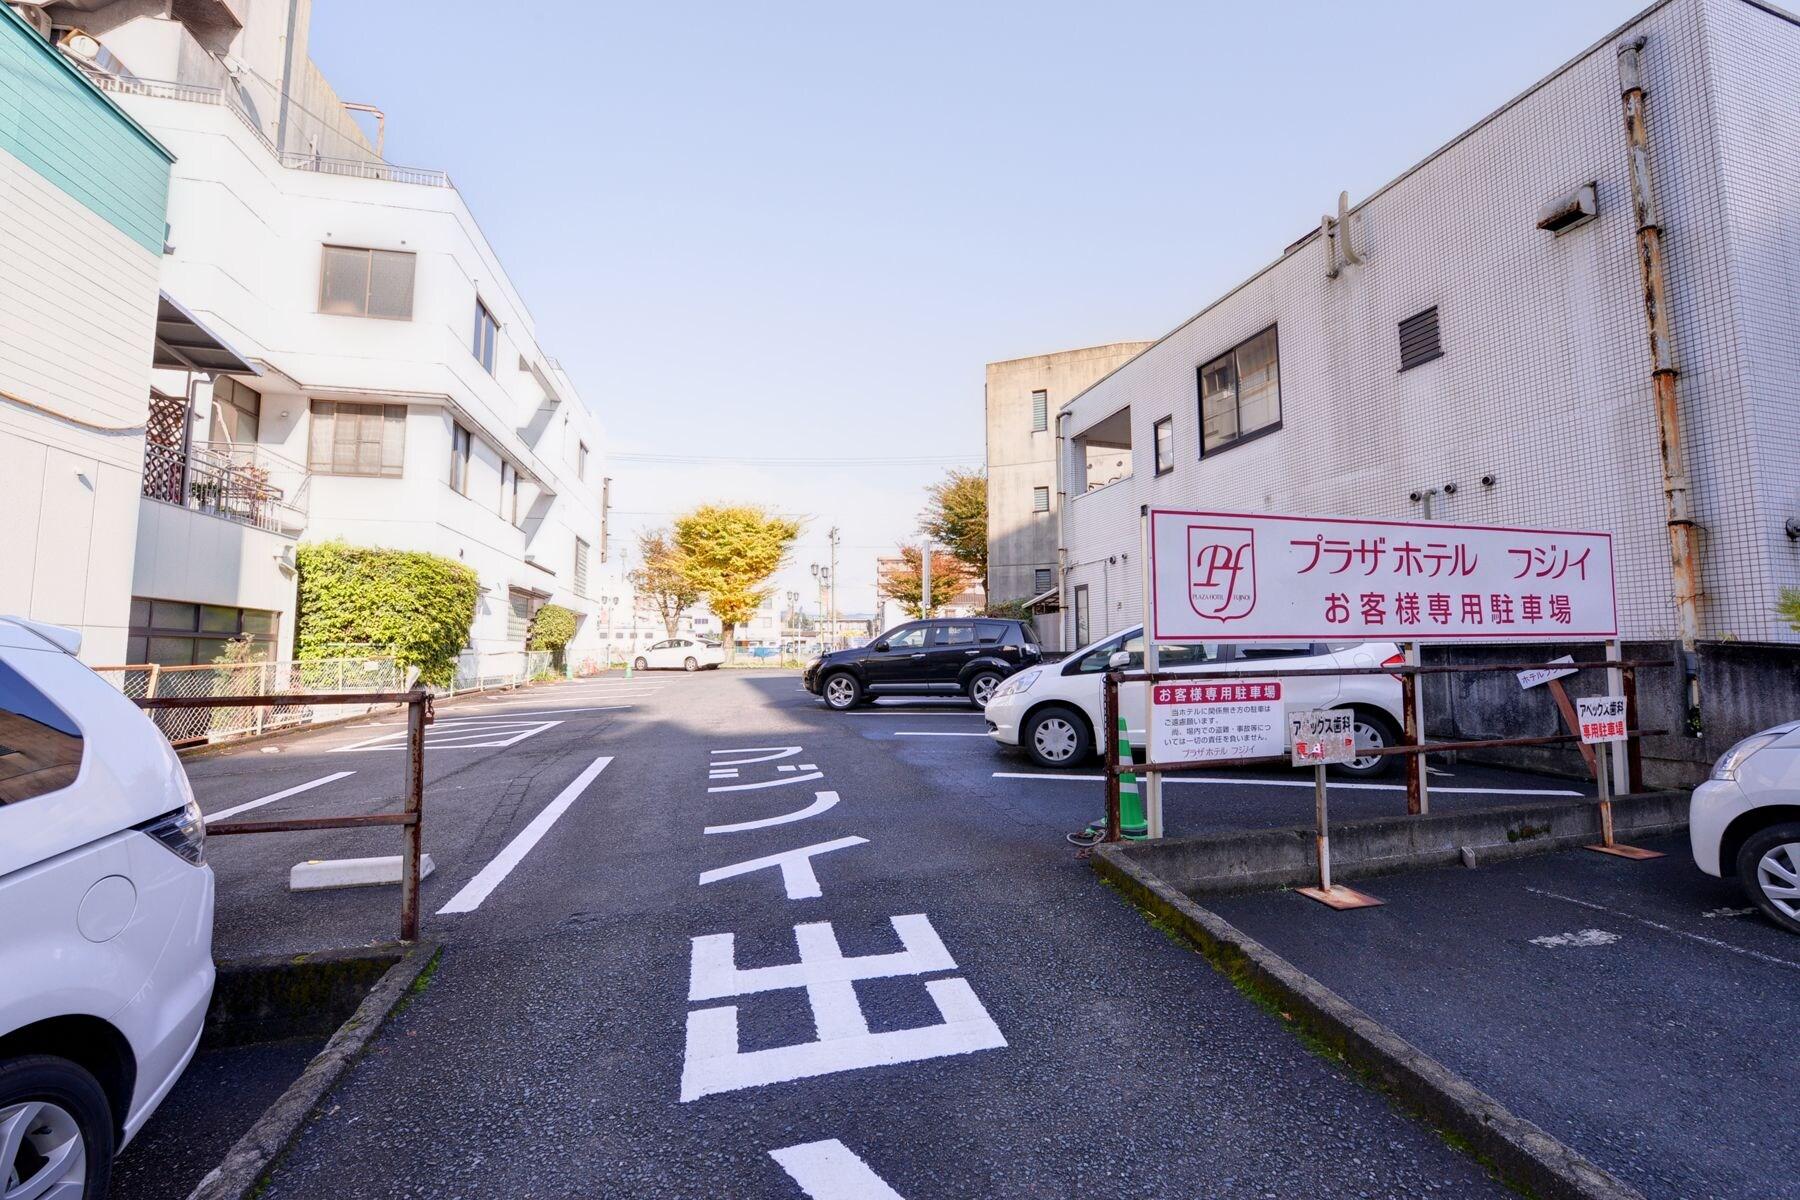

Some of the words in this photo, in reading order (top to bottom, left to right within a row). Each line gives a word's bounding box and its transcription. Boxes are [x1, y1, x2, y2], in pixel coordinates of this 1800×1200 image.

[1508, 543, 1591, 581] フジノイ
[1324, 591, 1571, 626] お客様専用駐車場
[1158, 684, 1275, 703] お客様専用駐車場
[1582, 720, 1625, 739] 専用駐車場
